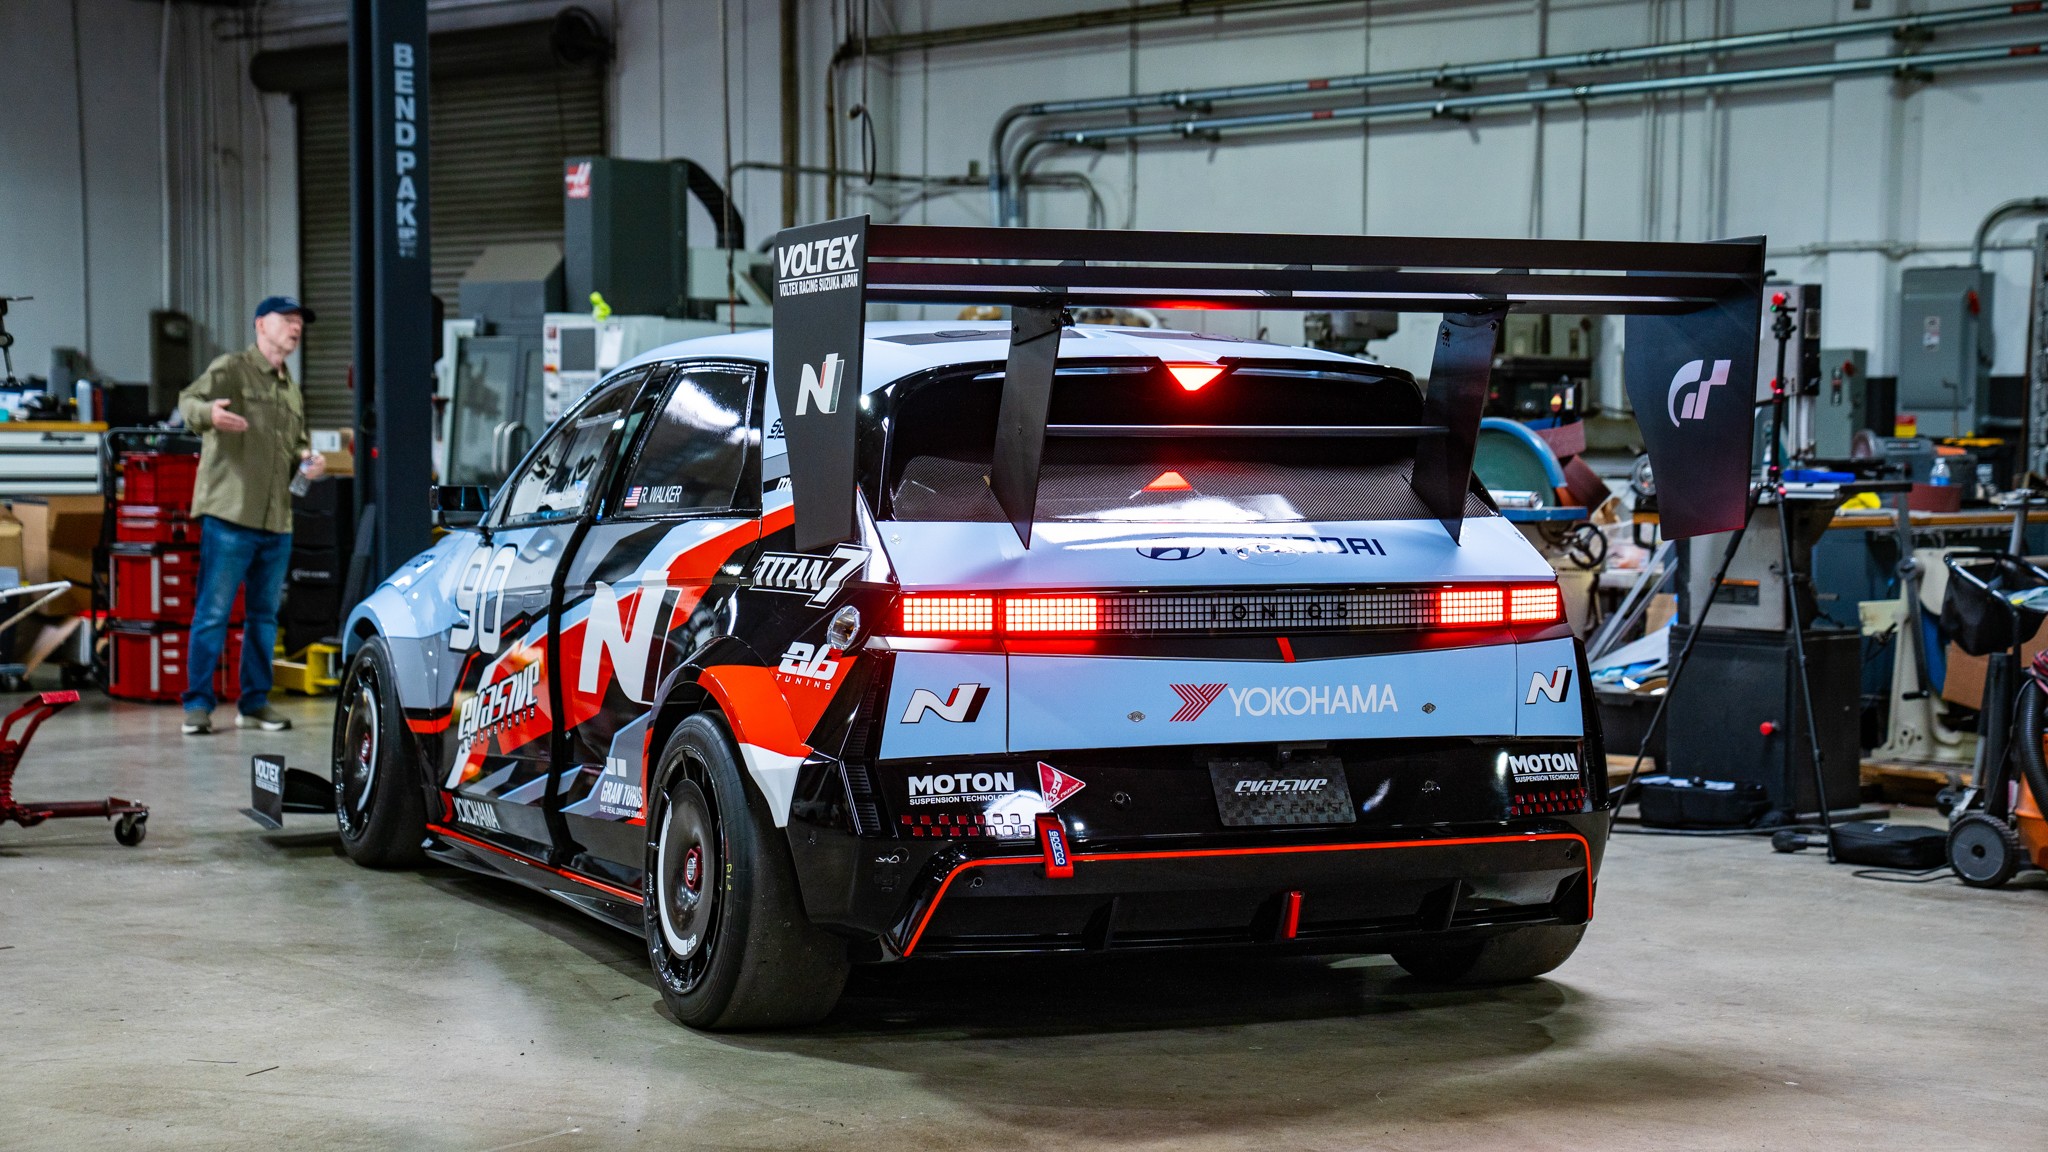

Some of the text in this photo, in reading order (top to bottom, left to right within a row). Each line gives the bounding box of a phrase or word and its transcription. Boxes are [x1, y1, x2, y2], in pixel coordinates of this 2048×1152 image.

[393, 43, 417, 226] BENDPAK
[778, 233, 859, 278] VOLTEX
[779, 273, 858, 297] VOLTEX RACING SUZUKA JAPAN
[649, 485, 682, 503] WALKER
[449, 543, 517, 655] 90
[1212, 602, 1348, 620] IONIQ 5
[775, 673, 832, 691] TUNING
[1228, 683, 1399, 717] YOKOHAMA
[254, 758, 280, 784] VOLTEX
[1508, 752, 1579, 774] MOTON
[907, 771, 1015, 796] MOTON
[1514, 773, 1580, 783] SUSPENSION TECHNOLOGY
[600, 780, 623, 805] GRAN
[909, 796, 960, 806] SUSPENSION
[1047, 780, 1062, 803] TOW
[452, 796, 501, 829] YOKOHAMA
